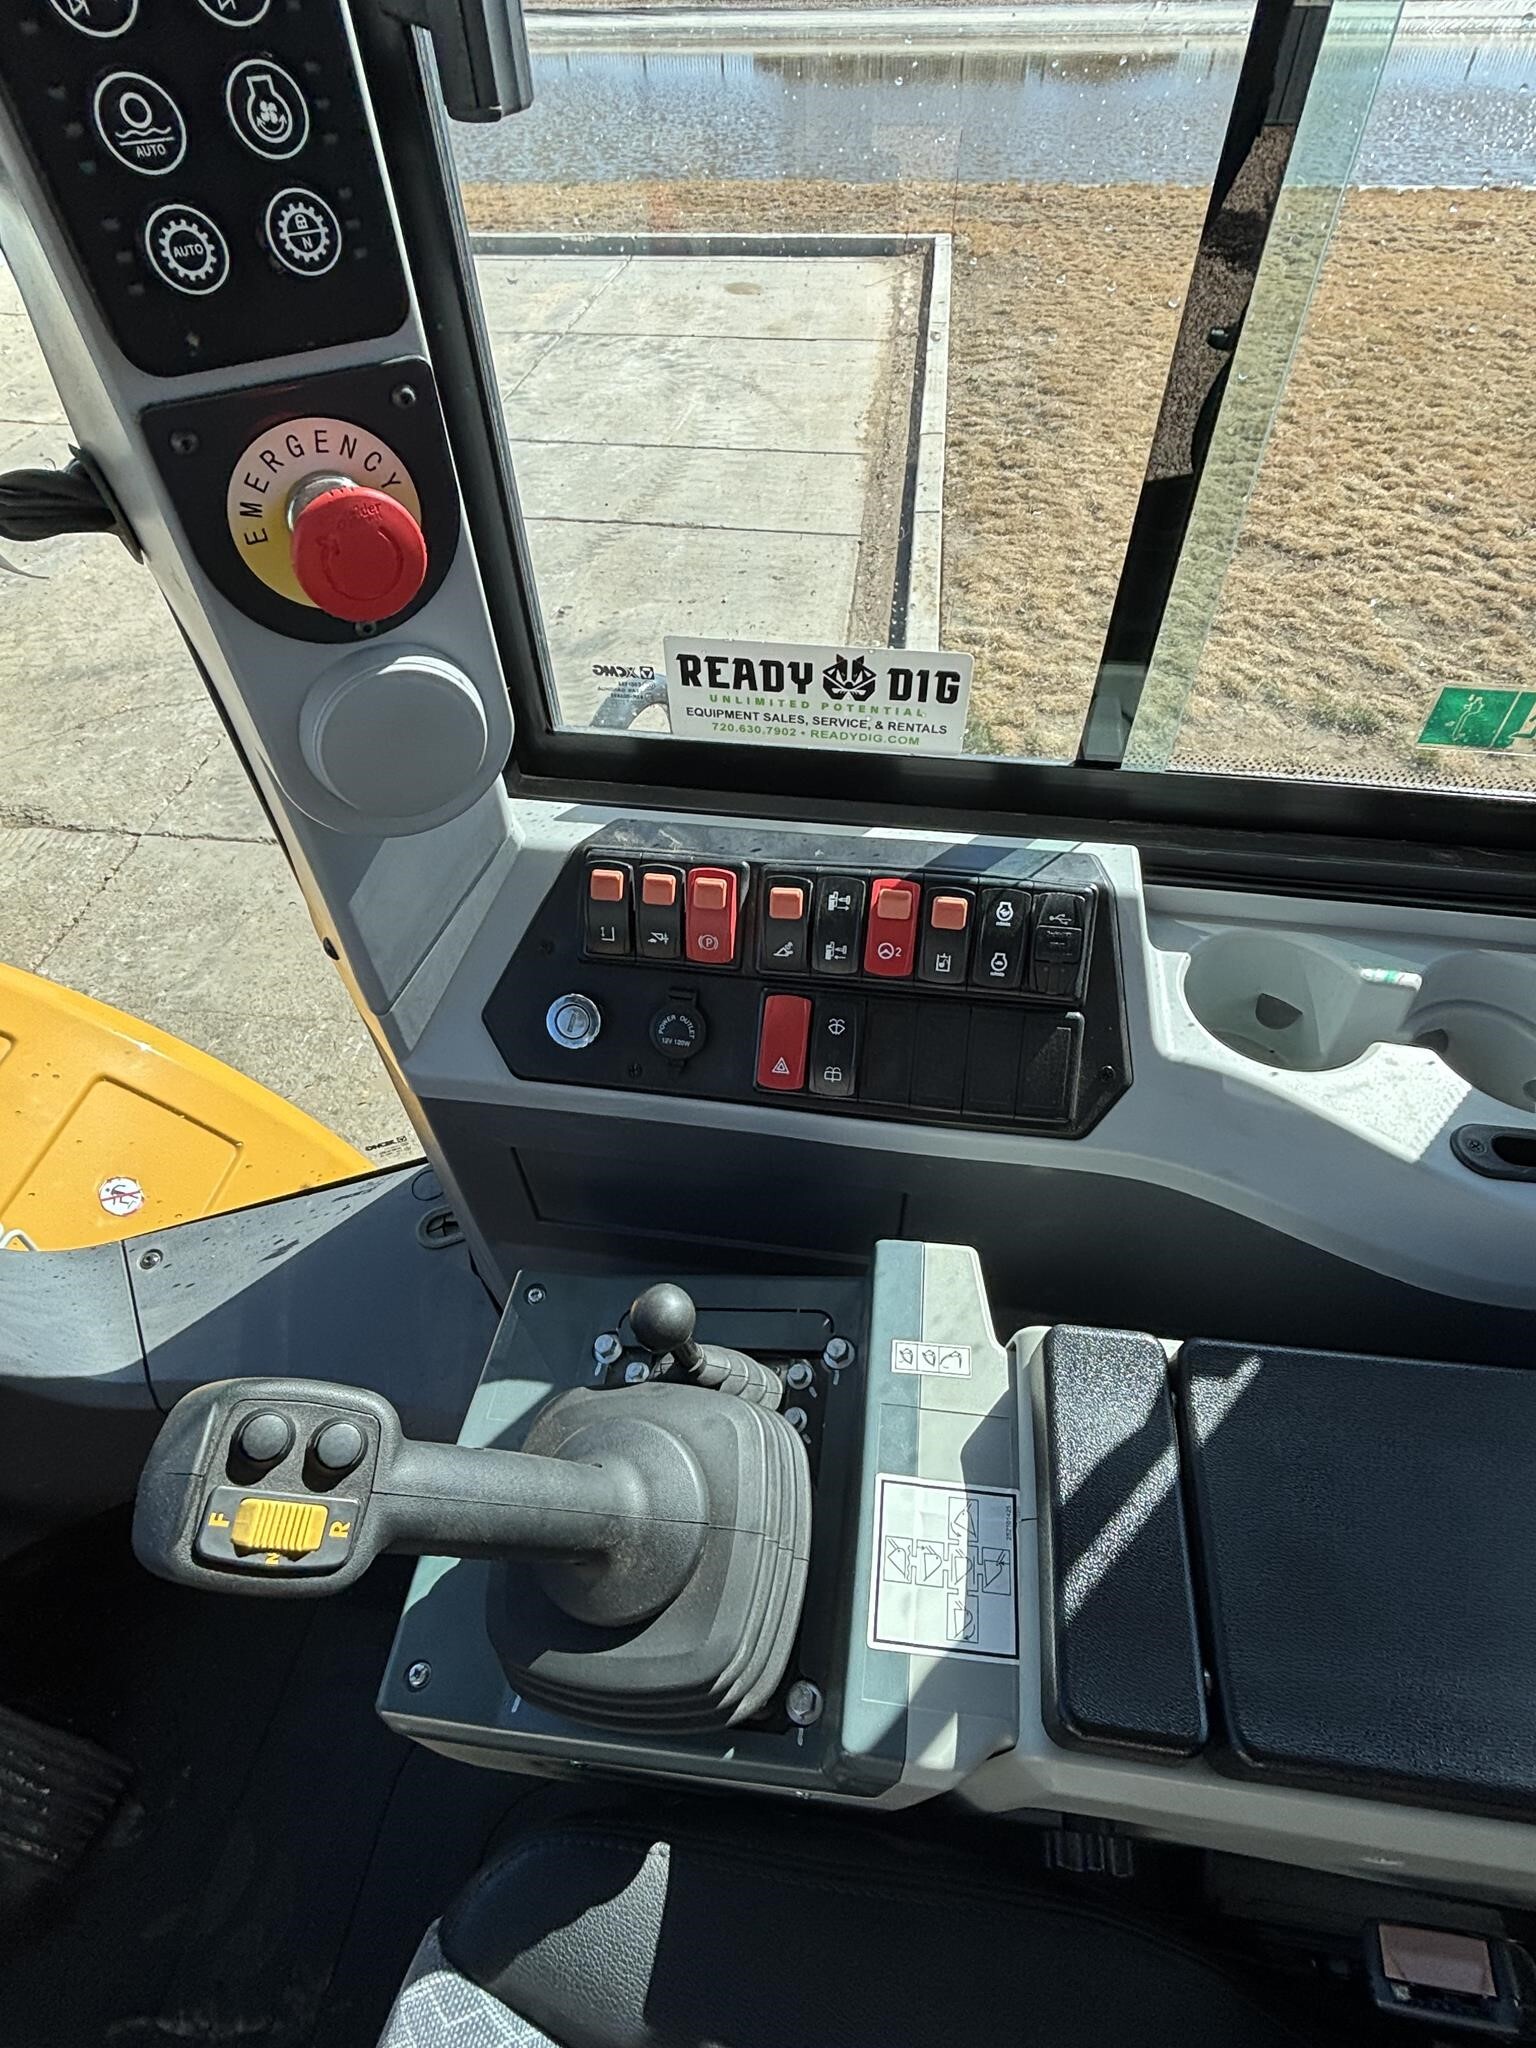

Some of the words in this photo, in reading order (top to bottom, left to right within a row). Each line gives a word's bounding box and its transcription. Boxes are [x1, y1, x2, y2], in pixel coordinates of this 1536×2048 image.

[136, 143, 167, 159] AUTO
[173, 242, 204, 259] AUTO
[301, 236, 313, 251] N
[239, 429, 402, 546] EMERGENCY
[676, 653, 814, 695] READY
[887, 667, 961, 705] DIG
[709, 694, 810, 709] UNLIMITED
[821, 702, 923, 718] POTENTIAL
[686, 706, 760, 721] EQUIPMENT
[763, 712, 809, 727] SALES,
[812, 716, 872, 731] SERVICE,
[874, 722, 884, 731] &
[887, 721, 948, 735] RENTALS
[711, 722, 797, 737] 720.630.7902
[810, 729, 920, 746] READYDIG.COM
[895, 946, 902, 957] 2
[658, 1014, 676, 1035] POWER
[679, 1015, 696, 1040] OUTLET
[208, 1512, 230, 1529] F
[328, 1520, 351, 1539] R
